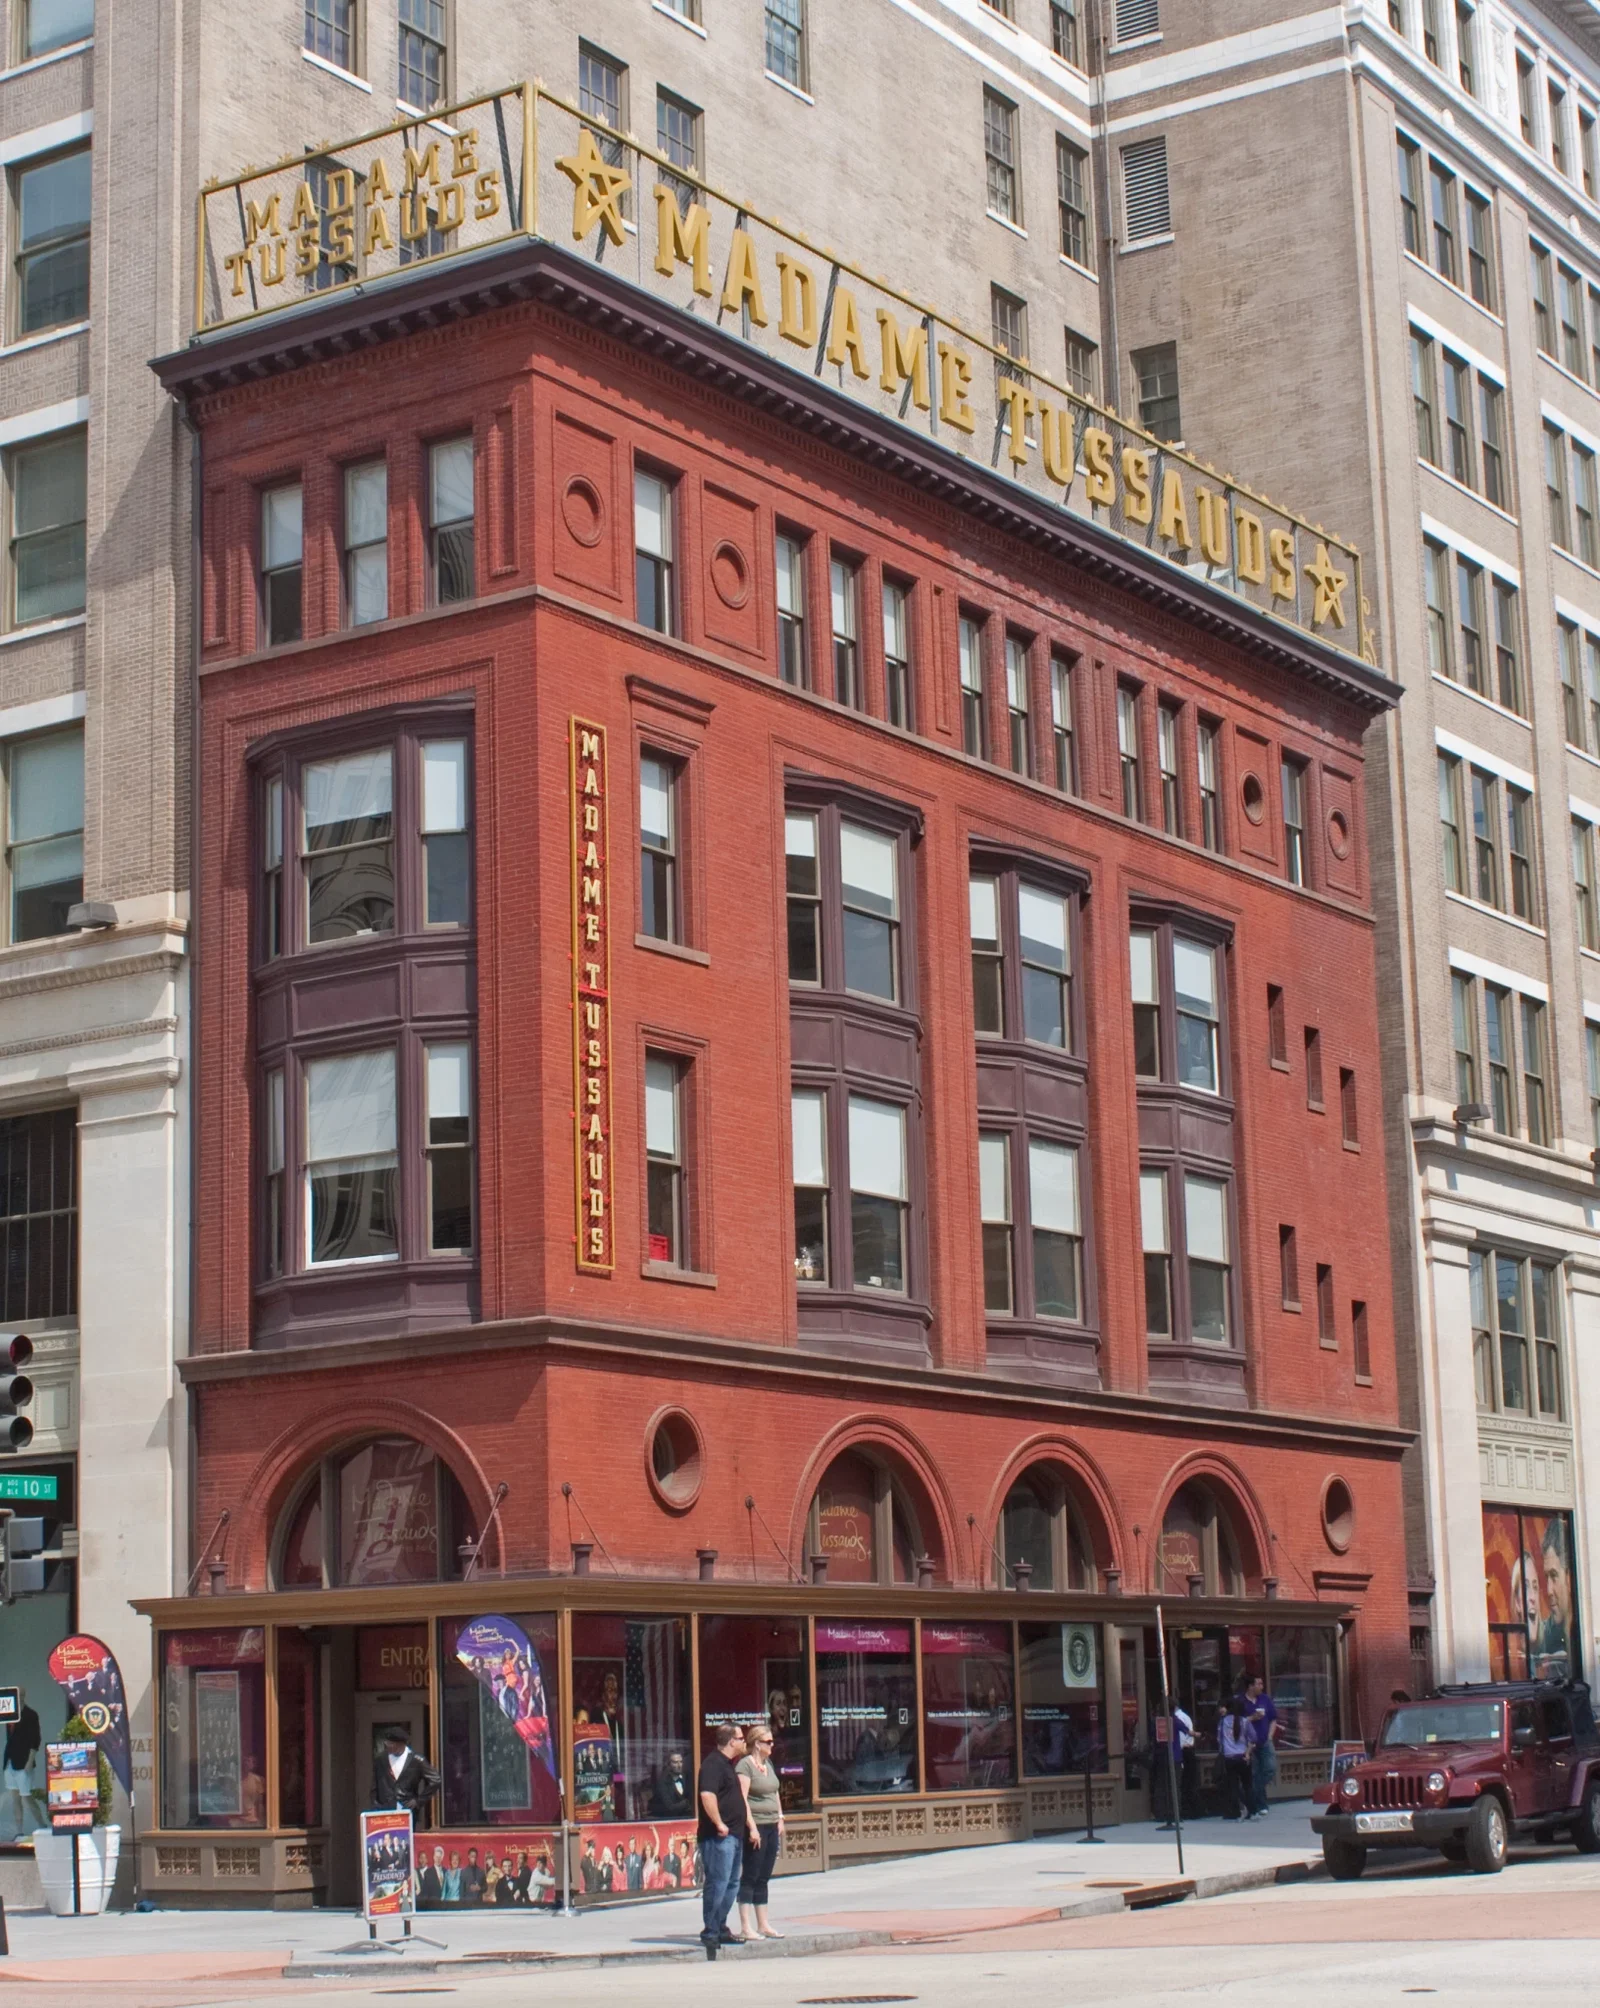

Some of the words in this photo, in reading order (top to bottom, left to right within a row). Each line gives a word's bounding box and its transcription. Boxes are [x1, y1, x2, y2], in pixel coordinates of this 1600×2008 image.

[223, 169, 502, 297] TUSSAUDS
[245, 128, 481, 247] MADAME
[654, 183, 976, 434] MADAME
[998, 376, 1297, 602] TUSSAUDS
[581, 730, 601, 943] MADAME
[585, 962, 604, 1256] TUSSAUDS
[24, 1479, 40, 1497] 10
[371, 1871, 405, 1883] PRESIDENTS
